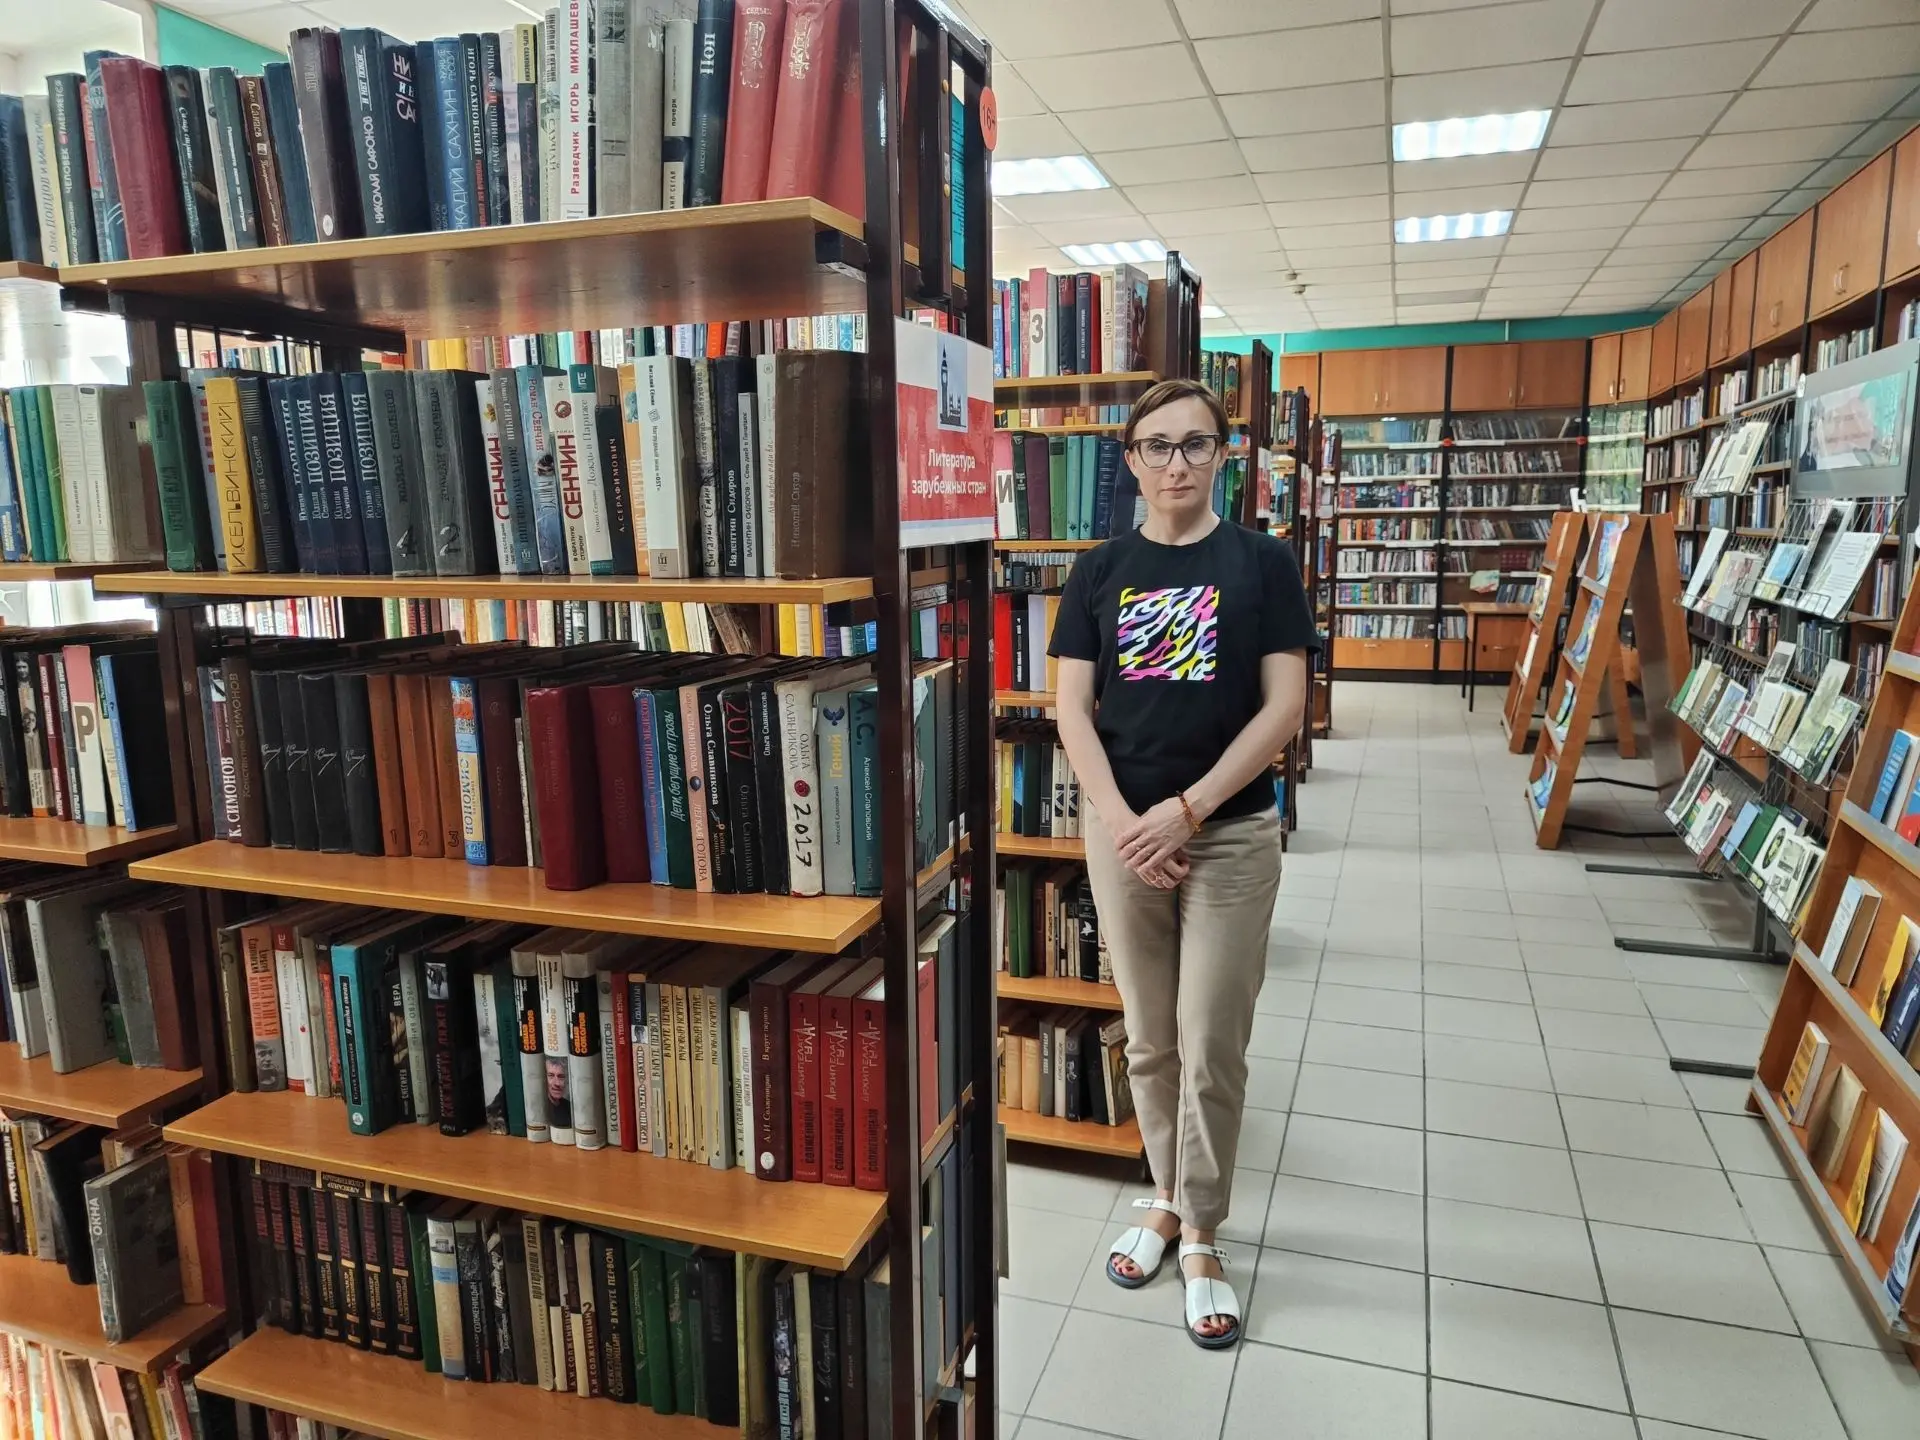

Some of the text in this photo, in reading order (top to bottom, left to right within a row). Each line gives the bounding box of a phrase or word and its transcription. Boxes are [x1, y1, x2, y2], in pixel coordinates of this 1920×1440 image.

[467, 48, 478, 82] ИГОРЬ
[699, 32, 717, 75] Поп
[358, 79, 369, 96] НЕТ
[569, 82, 580, 124] ИГОРЬ
[249, 103, 264, 138] Санаев
[443, 88, 463, 158] САХНИН
[469, 84, 484, 156] САХНОВСКИЙ
[670, 98, 679, 127] почерк
[547, 117, 561, 172] СЛУЧАЙ
[569, 131, 581, 195] Разведчик
[61, 148, 74, 193] ЧЕЛОВЕК
[362, 116, 386, 224] НИКОЛАЙ САФОНОВ
[669, 170, 678, 193] СЕГАЛ
[41, 178, 56, 228] ПОПЦОВ
[648, 364, 656, 389] Виталий
[501, 376, 516, 441] Роман СЕНЧИН
[527, 377, 546, 452] РОМАН СЕНЧИН
[579, 399, 594, 442] Париже
[250, 435, 265, 476] Семенов
[296, 398, 325, 485] ПОЗИЦИЯ
[318, 391, 347, 483] ПОЗИЦИЯ
[350, 392, 379, 482] ПОЗИЦИЯ
[742, 446, 751, 463] дней
[928, 449, 976, 469] Литература
[487, 436, 511, 520] СЕНЧИН
[556, 434, 584, 520] СЕНЧИН
[584, 451, 598, 487] Дождь
[608, 437, 626, 533] А. СЕРАФИМОВИЧ
[743, 464, 751, 479] Семь
[911, 478, 986, 499] зарубежных стран
[997, 471, 1014, 503] И
[310, 491, 322, 520] Юлиан
[332, 490, 344, 520] Юлиан
[341, 485, 353, 520] Семенов
[364, 489, 376, 519] Юлиан
[726, 469, 739, 567] Валентин Сидоров
[743, 486, 753, 519] СИДОРОВ
[568, 526, 578, 557] ОБРАТНУЮ
[578, 535, 586, 561] СТОРОНУ
[703, 523, 717, 568] Виталий
[745, 522, 754, 558] ВАЛЕНТИН
[228, 672, 245, 736] СИМОНОВ
[758, 691, 771, 756] Ольга Славникова
[686, 713, 700, 773] СЛАВНИКОВА
[724, 701, 754, 760] 2017
[784, 692, 799, 770] СЛАВНИКОВА
[798, 733, 810, 769] ОЛЬГА
[662, 709, 686, 822] Дети, бегущие от грозы
[702, 703, 721, 805] Ольга Славникова
[826, 733, 844, 779] Гений
[219, 756, 241, 823] СИМОНОВ
[459, 759, 474, 835] СИМОНОВ
[862, 756, 875, 840] Алексей Слаповский
[227, 824, 242, 838] К.
[448, 830, 459, 848] 3
[738, 783, 755, 888] Ольга Славникова
[792, 803, 813, 868] 2017
[833, 821, 842, 846] Алексей
[694, 837, 709, 882] ГОЛОВА
[391, 983, 403, 1007] ВЕРА
[660, 995, 671, 1027] ПЕРВОМ
[526, 1009, 537, 1051] СОКОЛОВ
[550, 1007, 560, 1052] СОКОЛОВ
[578, 1011, 589, 1054] СОКОЛОВ
[649, 1016, 661, 1047] ПЕРВОМ
[661, 1027, 672, 1052] КРУГЕ
[676, 1025, 688, 1062] РАКОВЫЙ
[693, 1025, 705, 1062] РАКОВЫЙ
[761, 1034, 771, 1054] круге
[791, 1016, 816, 1063] ГУЛАГ
[823, 1020, 848, 1066] ГУЛАГ
[857, 1021, 881, 1067] ГУЛАГ
[603, 1023, 619, 1133] И. СОКОЛОВ-МИКИТОВ
[650, 1047, 661, 1071] КРУГЕ
[793, 1037, 806, 1098] АРХИПЕЛАГ
[824, 1037, 838, 1100] АРХИПЕЛАГ
[857, 1039, 870, 1103] АРХИПЕЛАГ
[636, 1083, 648, 1145] ТРУДНО БЫТЬ
[734, 1078, 744, 1126] СОЛЖЕНИЦЫН
[761, 1074, 773, 1121] Солженицын
[762, 1134, 772, 1144] А.
[802, 1100, 815, 1164] СОЛЖЕНИЦЫН
[832, 1106, 845, 1171] СОЛЖЕНИЦЫН
[865, 1108, 879, 1173] СОЛЖЕНИЦЫН
[327, 1181, 361, 1194] АЛЕКСАНДР
[88, 1196, 103, 1236] ОКНА
[469, 1281, 482, 1334] СОЛЖЕНИЦЫН
[605, 1247, 619, 1325] В КРУГЕ ПЕРВОМ
